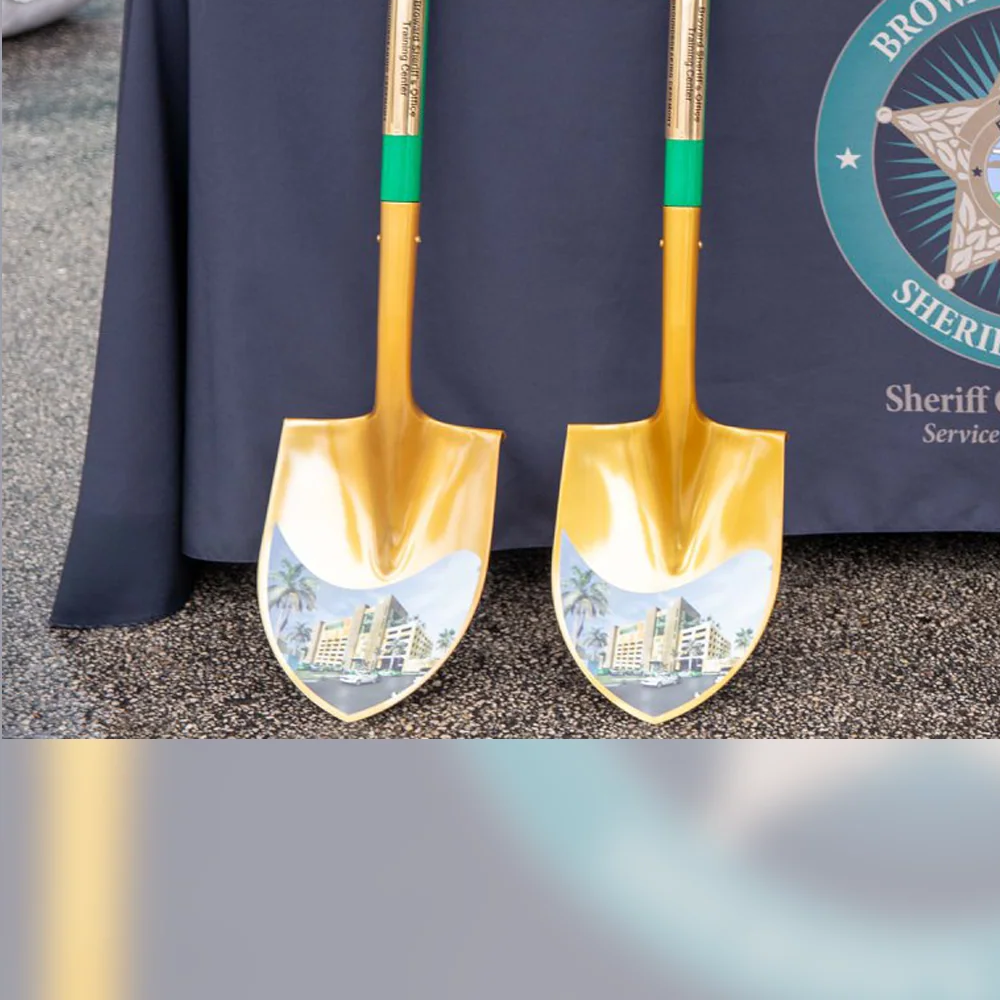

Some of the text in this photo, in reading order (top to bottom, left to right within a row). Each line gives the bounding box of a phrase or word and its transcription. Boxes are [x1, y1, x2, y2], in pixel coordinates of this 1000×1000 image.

[412, 0, 421, 42] Broward
[697, 6, 706, 47] Broward
[399, 21, 412, 96] Training Center
[685, 27, 696, 101] Training Center
[409, 88, 419, 117] Office
[885, 384, 990, 413] Sheriff
[922, 423, 1000, 444] Service
